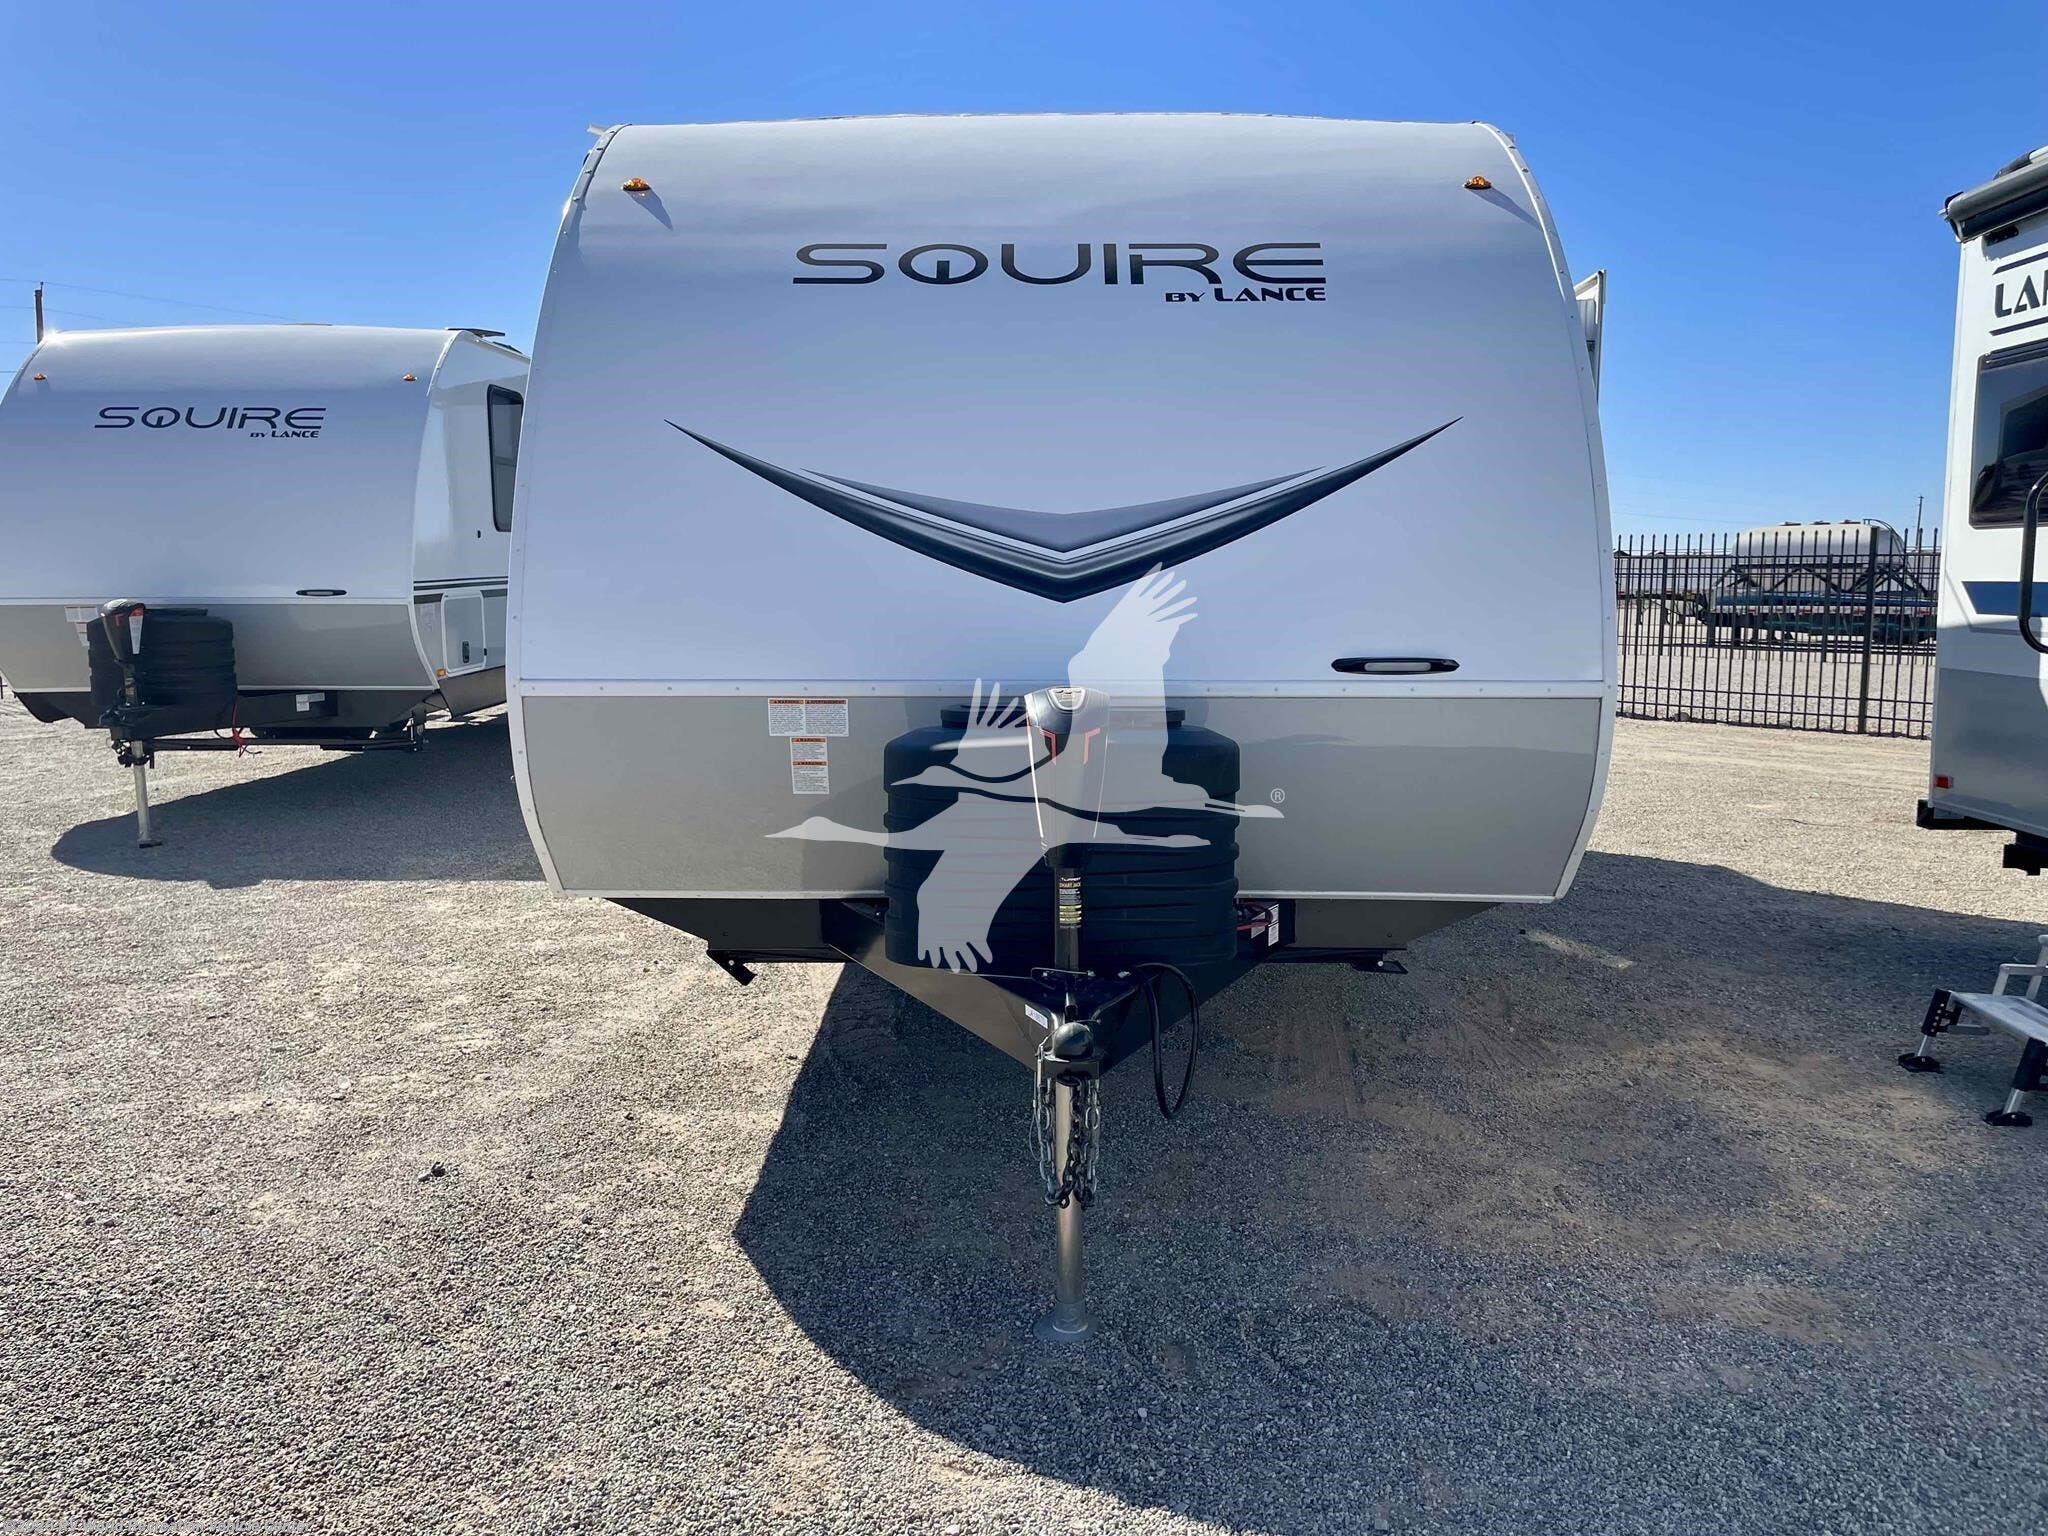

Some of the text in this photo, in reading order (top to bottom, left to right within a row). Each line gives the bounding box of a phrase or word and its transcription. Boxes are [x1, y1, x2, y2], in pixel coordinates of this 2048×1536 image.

[792, 242, 1327, 285] SQUIRE
[1165, 287, 1327, 303] BY LANCE
[94, 406, 327, 430] SQUIRE
[271, 430, 319, 438] LANCE
